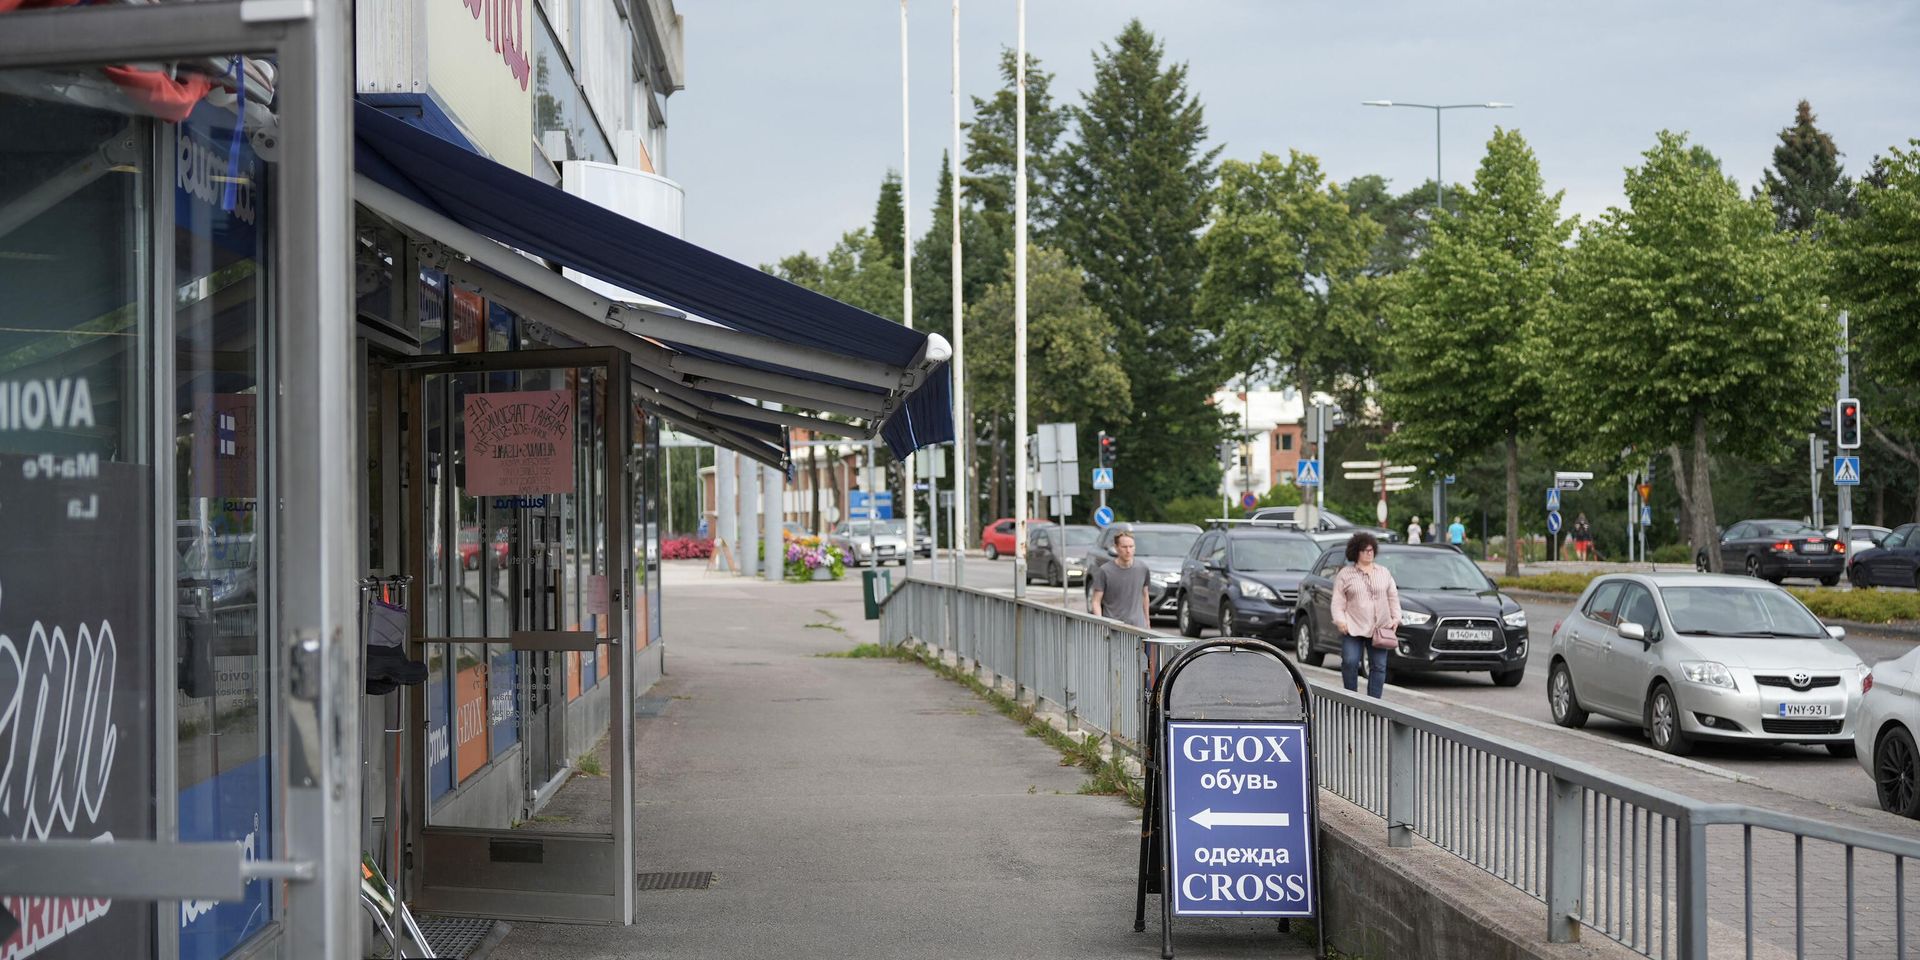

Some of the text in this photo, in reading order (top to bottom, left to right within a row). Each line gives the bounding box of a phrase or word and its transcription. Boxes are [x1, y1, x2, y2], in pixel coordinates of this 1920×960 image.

[1787, 705, 1828, 715] VNY-931
[1183, 735, 1291, 763] GEOX
[1200, 768, 1278, 795] обувь
[1194, 847, 1290, 867] одежда
[1182, 873, 1305, 902] CROSS
